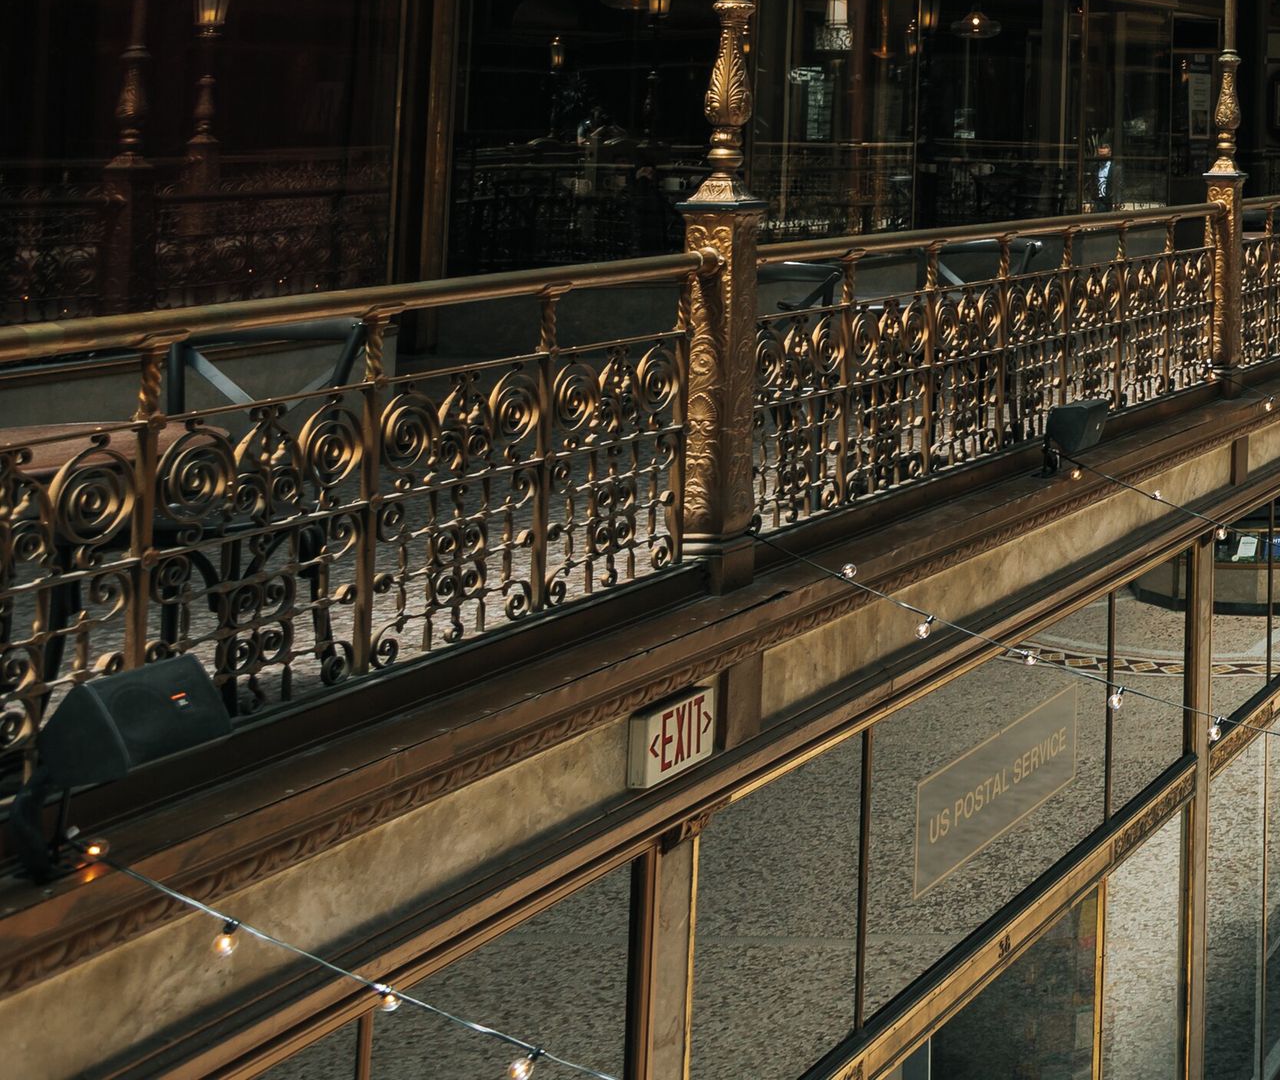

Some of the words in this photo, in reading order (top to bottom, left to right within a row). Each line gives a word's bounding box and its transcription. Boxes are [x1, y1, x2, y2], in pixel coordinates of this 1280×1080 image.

[661, 695, 704, 772] EXIT
[929, 808, 950, 843] US
[954, 769, 1010, 826] POSTAL
[1013, 727, 1066, 783] SERVICE
